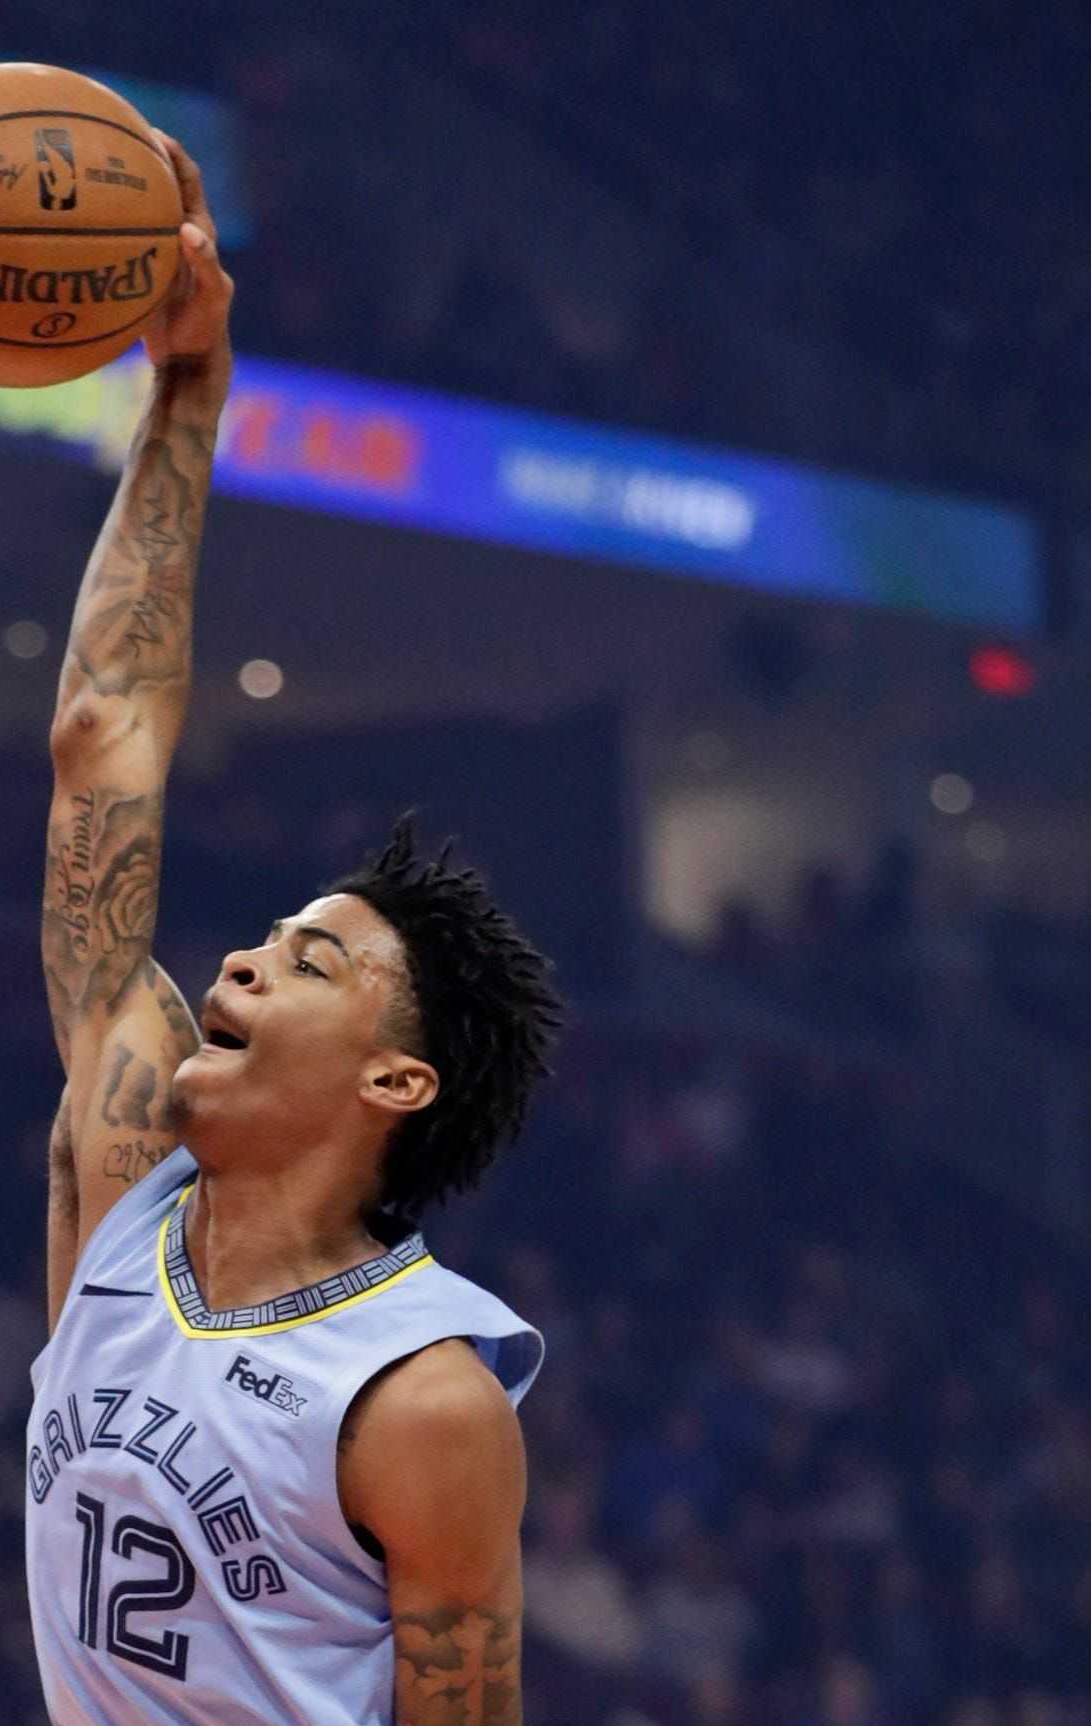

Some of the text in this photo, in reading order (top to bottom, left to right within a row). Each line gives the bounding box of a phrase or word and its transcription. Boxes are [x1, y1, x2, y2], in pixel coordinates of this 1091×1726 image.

[225, 1355, 308, 1417] FedEx
[27, 1388, 287, 1602] GRIZZLIES
[75, 1492, 196, 1682] 12
